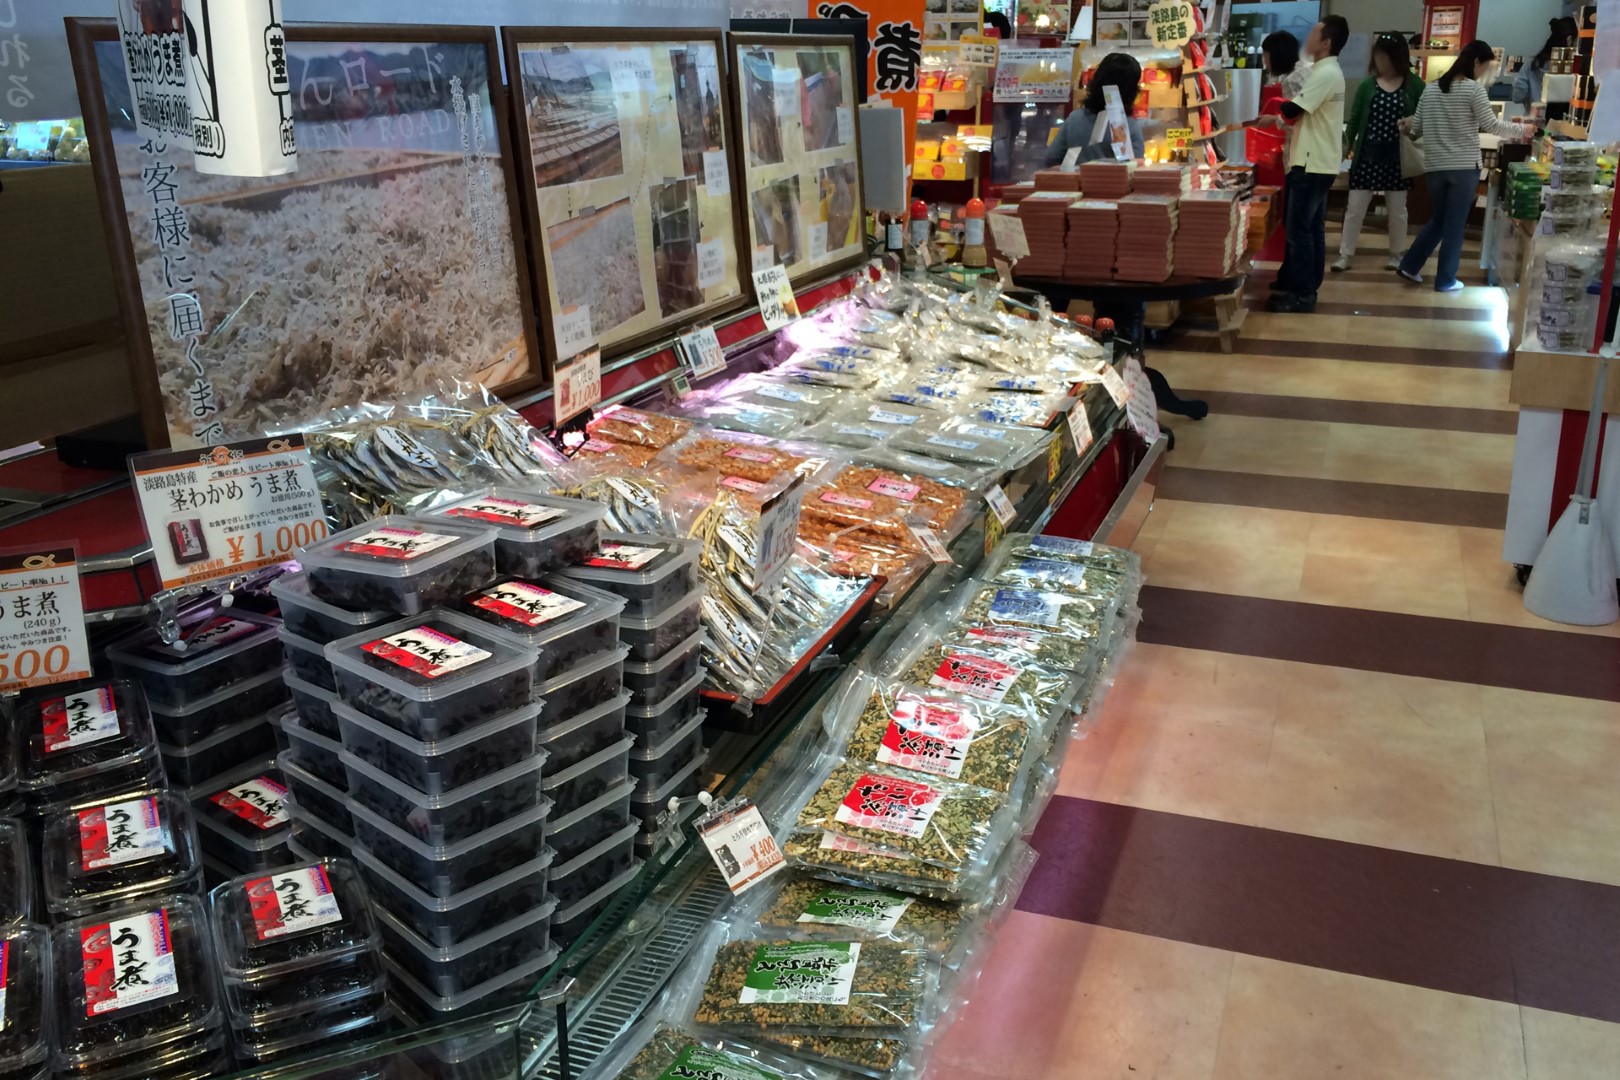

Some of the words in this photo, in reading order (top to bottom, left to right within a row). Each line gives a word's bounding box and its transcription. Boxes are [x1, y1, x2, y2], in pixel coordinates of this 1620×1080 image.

[1151, 5, 1189, 24] 淡路島の
[1157, 21, 1187, 42] 新定番
[376, 108, 451, 143] ROAD
[143, 470, 198, 492] 淡路島特産
[167, 481, 244, 513] 茎わかめ
[250, 468, 302, 498] うま煮
[64, 698, 98, 736] うま煮
[860, 796, 928, 822] 茶漬け
[104, 808, 141, 853] うま煮
[276, 877, 317, 922] うま煮
[110, 927, 151, 992] うま煮
